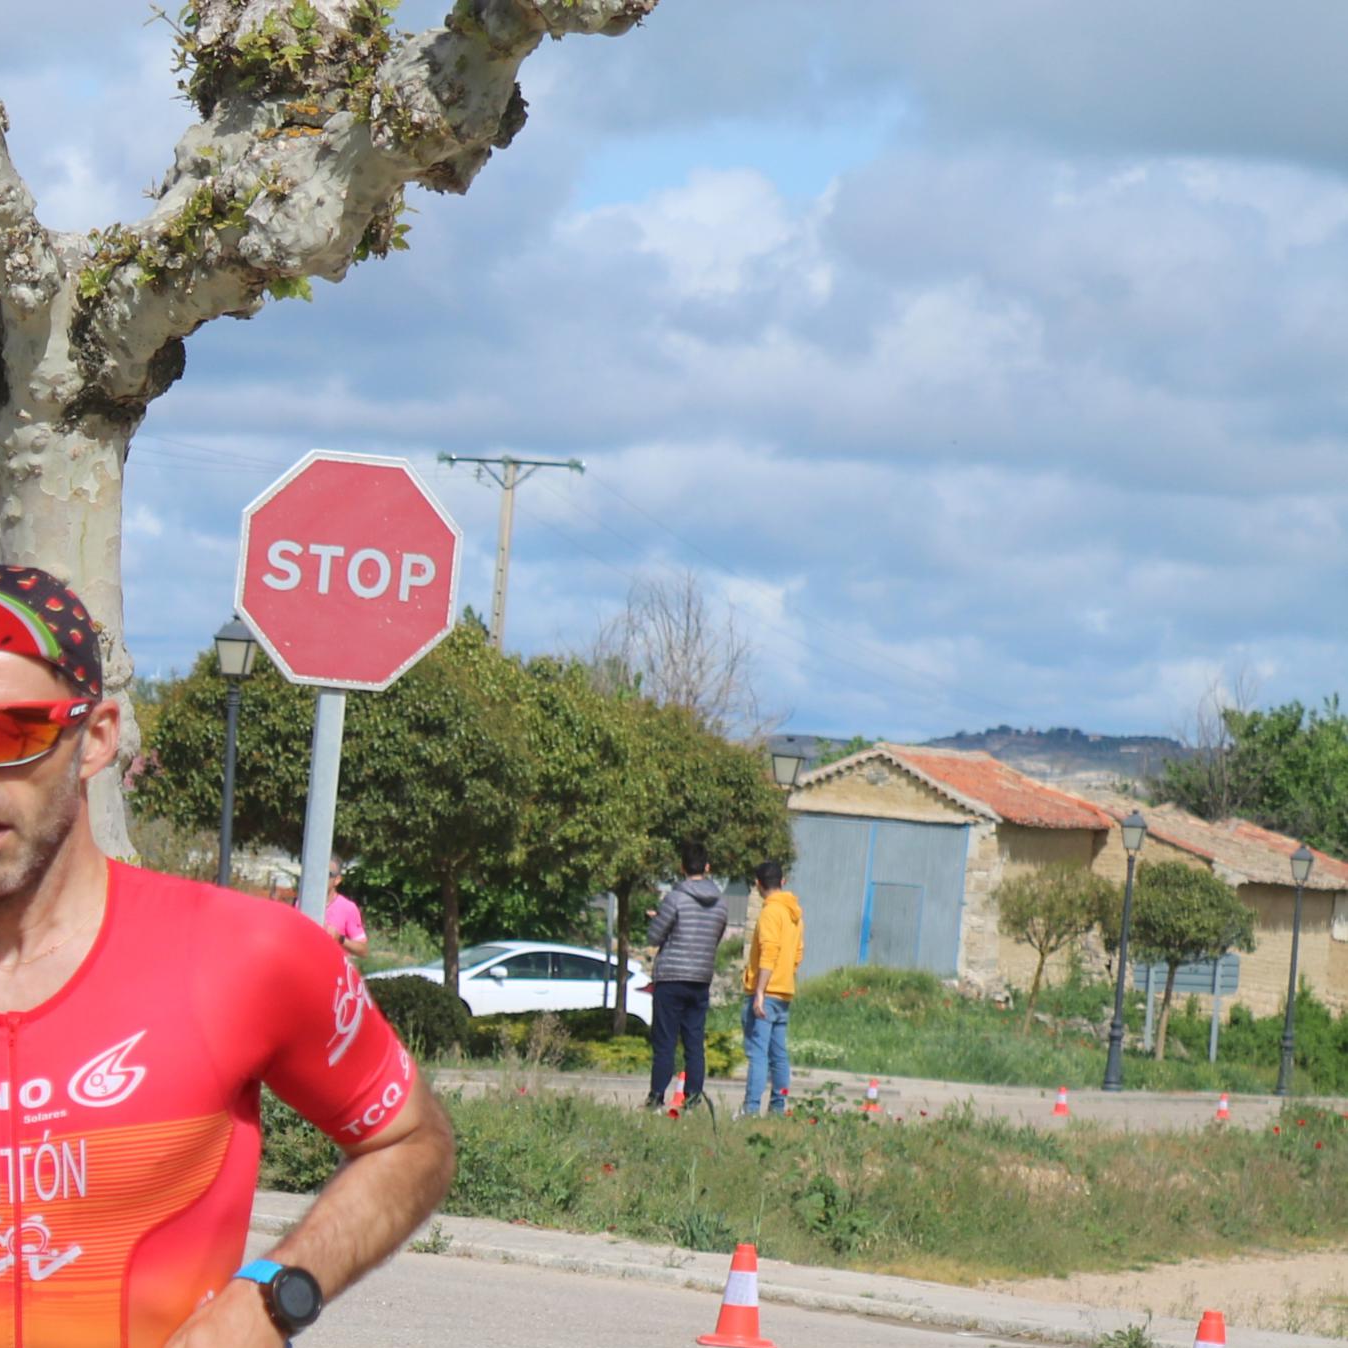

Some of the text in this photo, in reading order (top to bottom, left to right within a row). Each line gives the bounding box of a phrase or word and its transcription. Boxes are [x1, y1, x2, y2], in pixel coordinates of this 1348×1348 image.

[262, 540, 436, 602] STOP
[23, 1109, 68, 1125] Solares
[340, 1082, 403, 1137] TCQ
